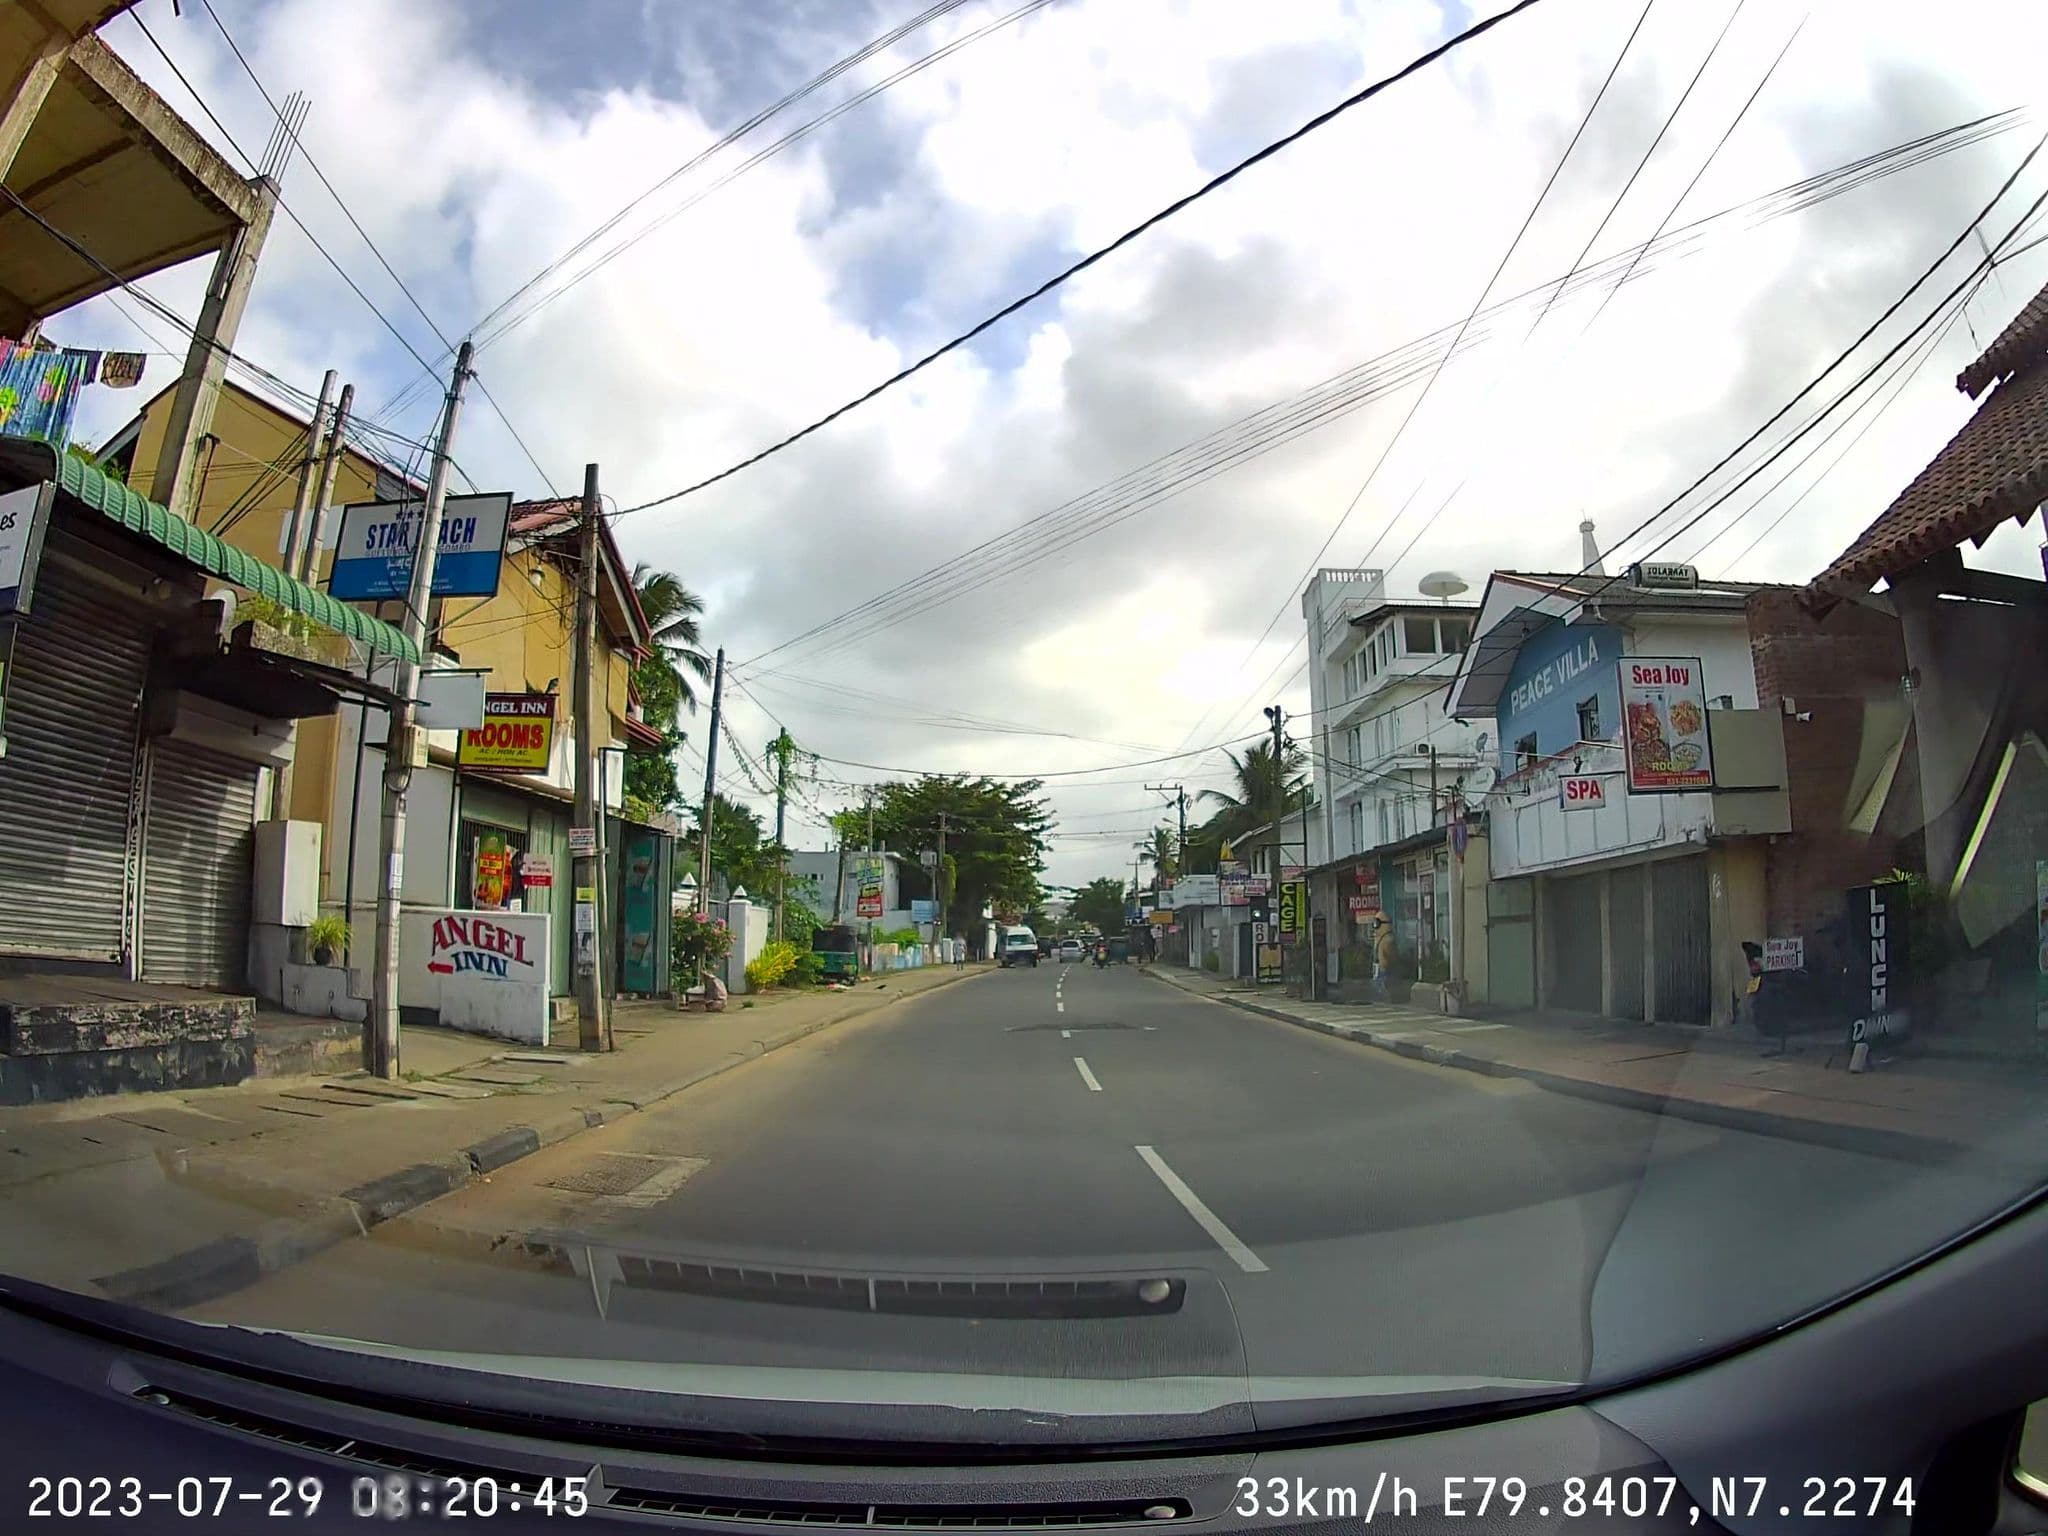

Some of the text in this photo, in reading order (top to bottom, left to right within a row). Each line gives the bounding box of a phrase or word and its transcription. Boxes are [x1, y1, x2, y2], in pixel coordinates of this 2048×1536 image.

[366, 517, 477, 550] STAR ACH
[1510, 636, 1599, 715] PEACE VILLA
[1632, 665, 1690, 686] Sea Joy
[484, 701, 548, 714] NGEL INN
[467, 722, 545, 751] ROOMS
[1566, 780, 1602, 800] SPA
[1281, 883, 1295, 933] CAGE
[432, 915, 534, 967] ANGEL
[1869, 888, 1887, 1012] LUNCH
[451, 951, 508, 977] INN
